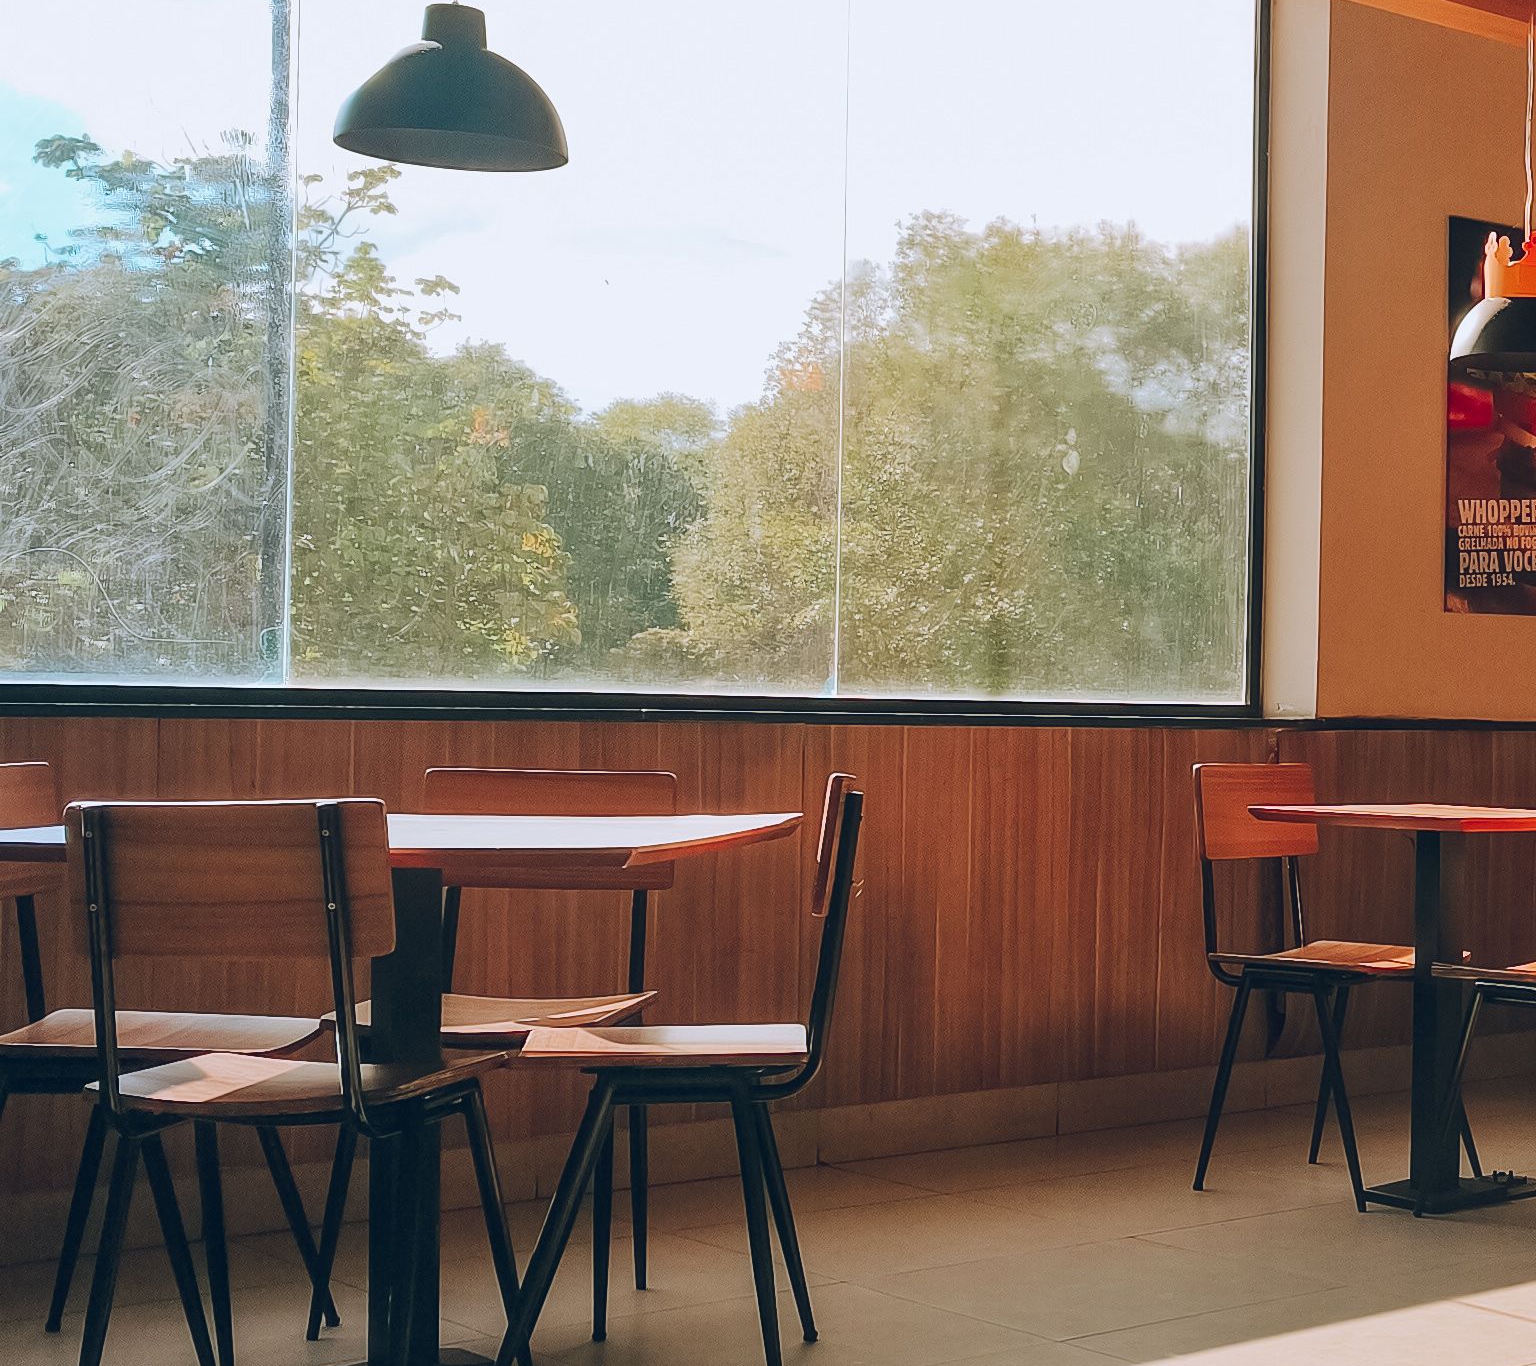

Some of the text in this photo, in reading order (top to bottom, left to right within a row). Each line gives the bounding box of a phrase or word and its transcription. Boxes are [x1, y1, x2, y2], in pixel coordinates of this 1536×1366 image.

[1458, 525, 1485, 537] CARNE
[1487, 525, 1512, 537] 100%
[1458, 537, 1504, 550] GRELHADA
[1506, 537, 1519, 550] NO
[1460, 552, 1500, 573] PARA
[1460, 573, 1516, 587] DESDE 1954.
